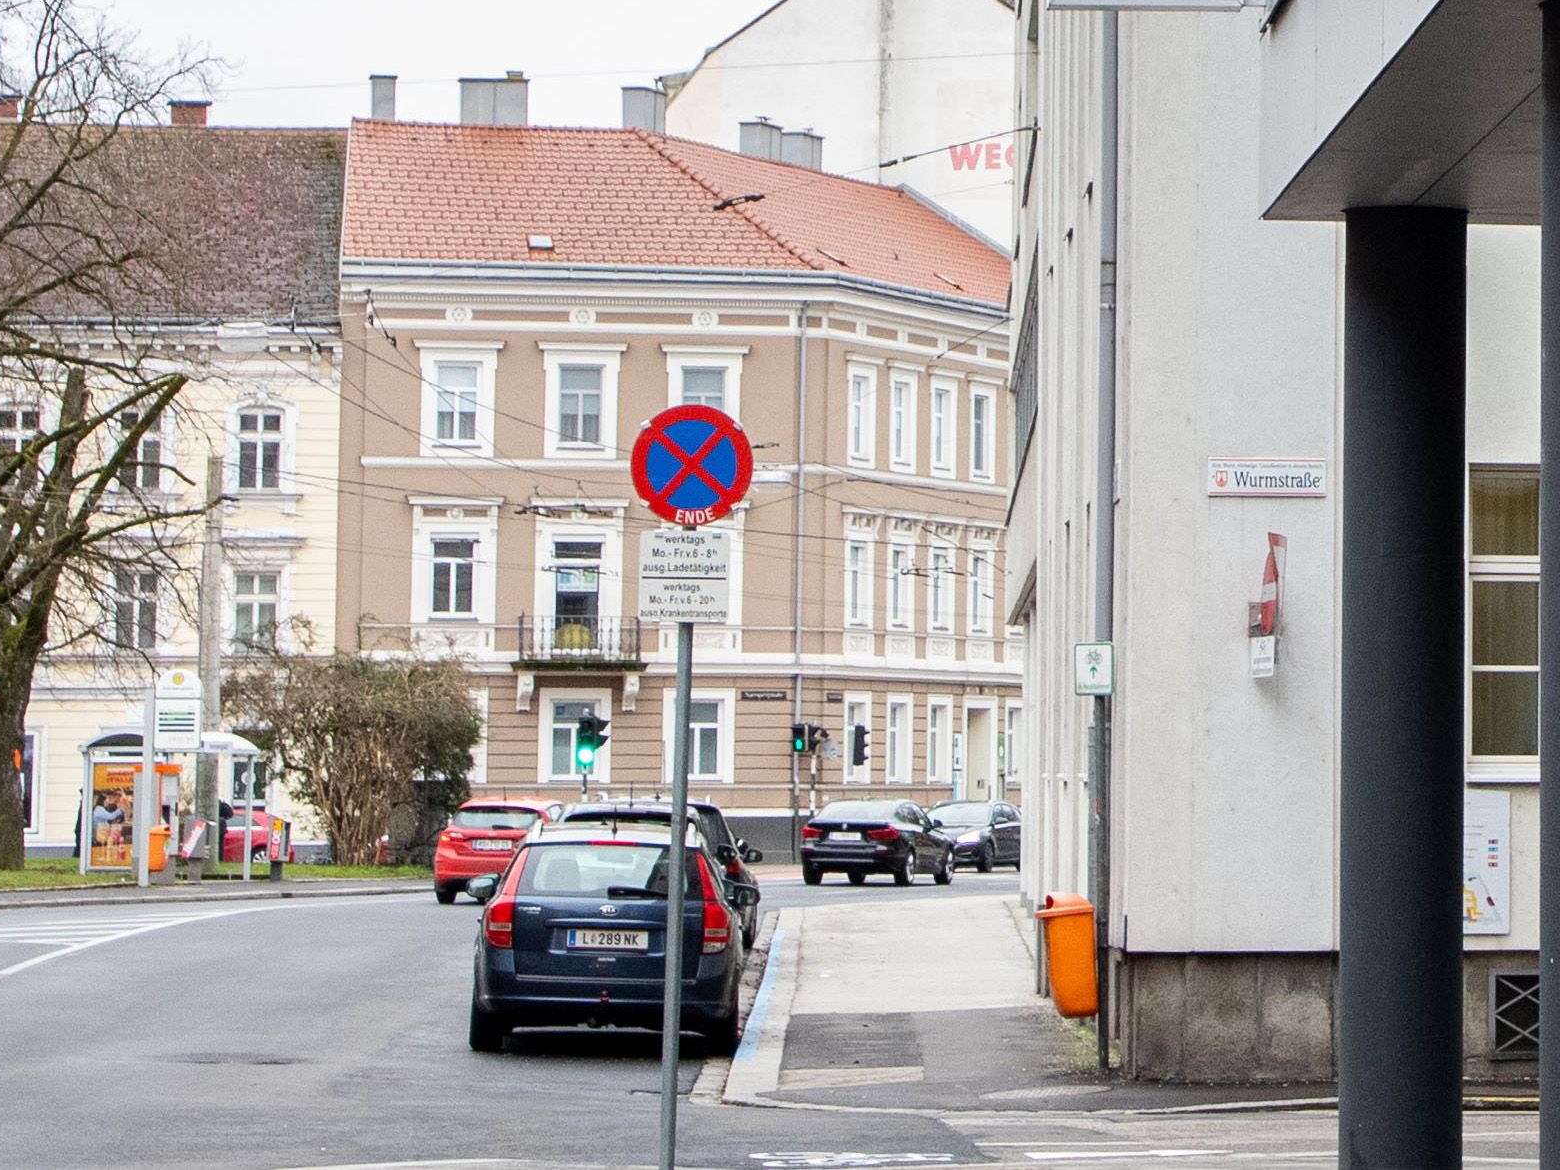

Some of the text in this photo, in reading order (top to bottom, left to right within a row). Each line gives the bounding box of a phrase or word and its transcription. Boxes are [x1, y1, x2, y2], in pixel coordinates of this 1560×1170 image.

[1234, 470, 1321, 489] Wurmstraße
[675, 507, 716, 524] ENDE
[665, 534, 706, 546] werktags
[663, 583, 701, 594] werktags
[582, 933, 639, 946] L 289 NK
